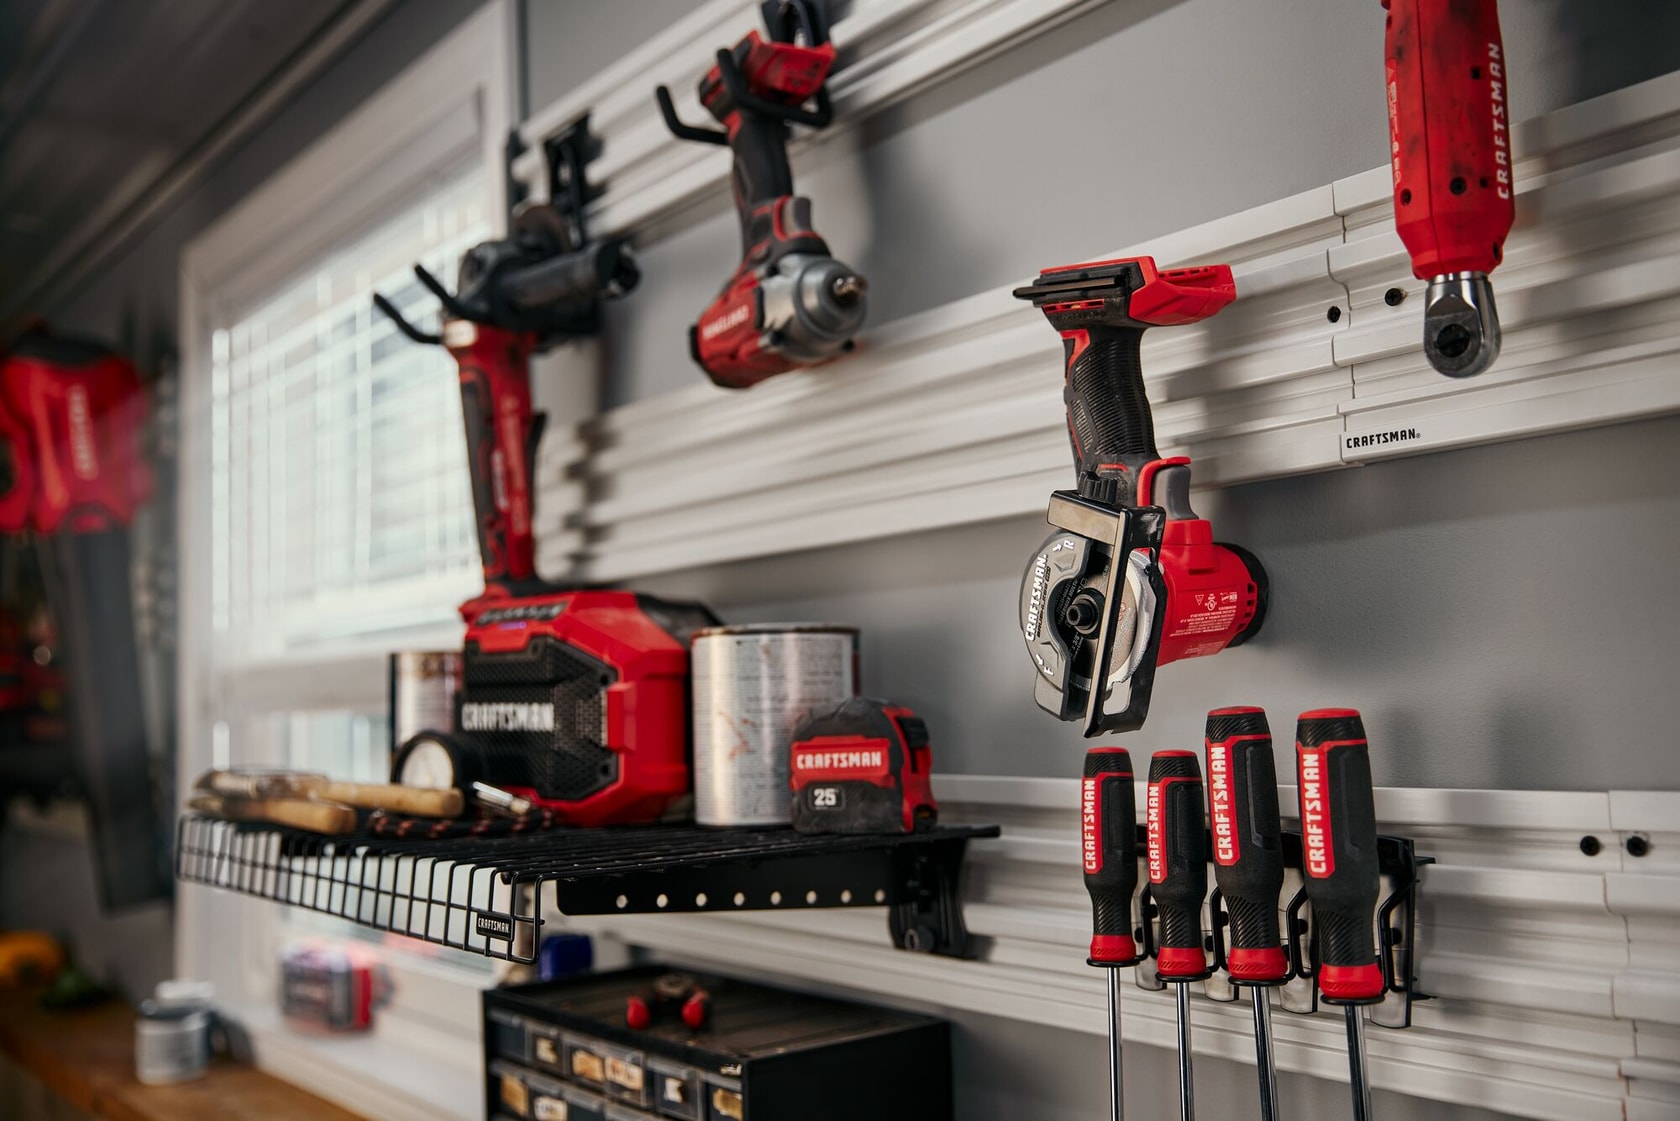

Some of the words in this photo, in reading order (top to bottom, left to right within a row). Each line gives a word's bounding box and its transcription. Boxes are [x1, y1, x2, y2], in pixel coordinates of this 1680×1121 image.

[1488, 41, 1511, 201] CRAFTSMAN
[462, 702, 555, 732] CRAFTSMAN
[796, 750, 882, 770] CRAFTSMAN
[1081, 779, 1097, 871] CRAFTSMAN
[1147, 785, 1162, 881] CRAFTSMAN
[1210, 745, 1233, 861] CRAFTSMAN
[1302, 753, 1327, 873] CRAFTSMAN
[477, 917, 510, 934] CRAFTSMAN
